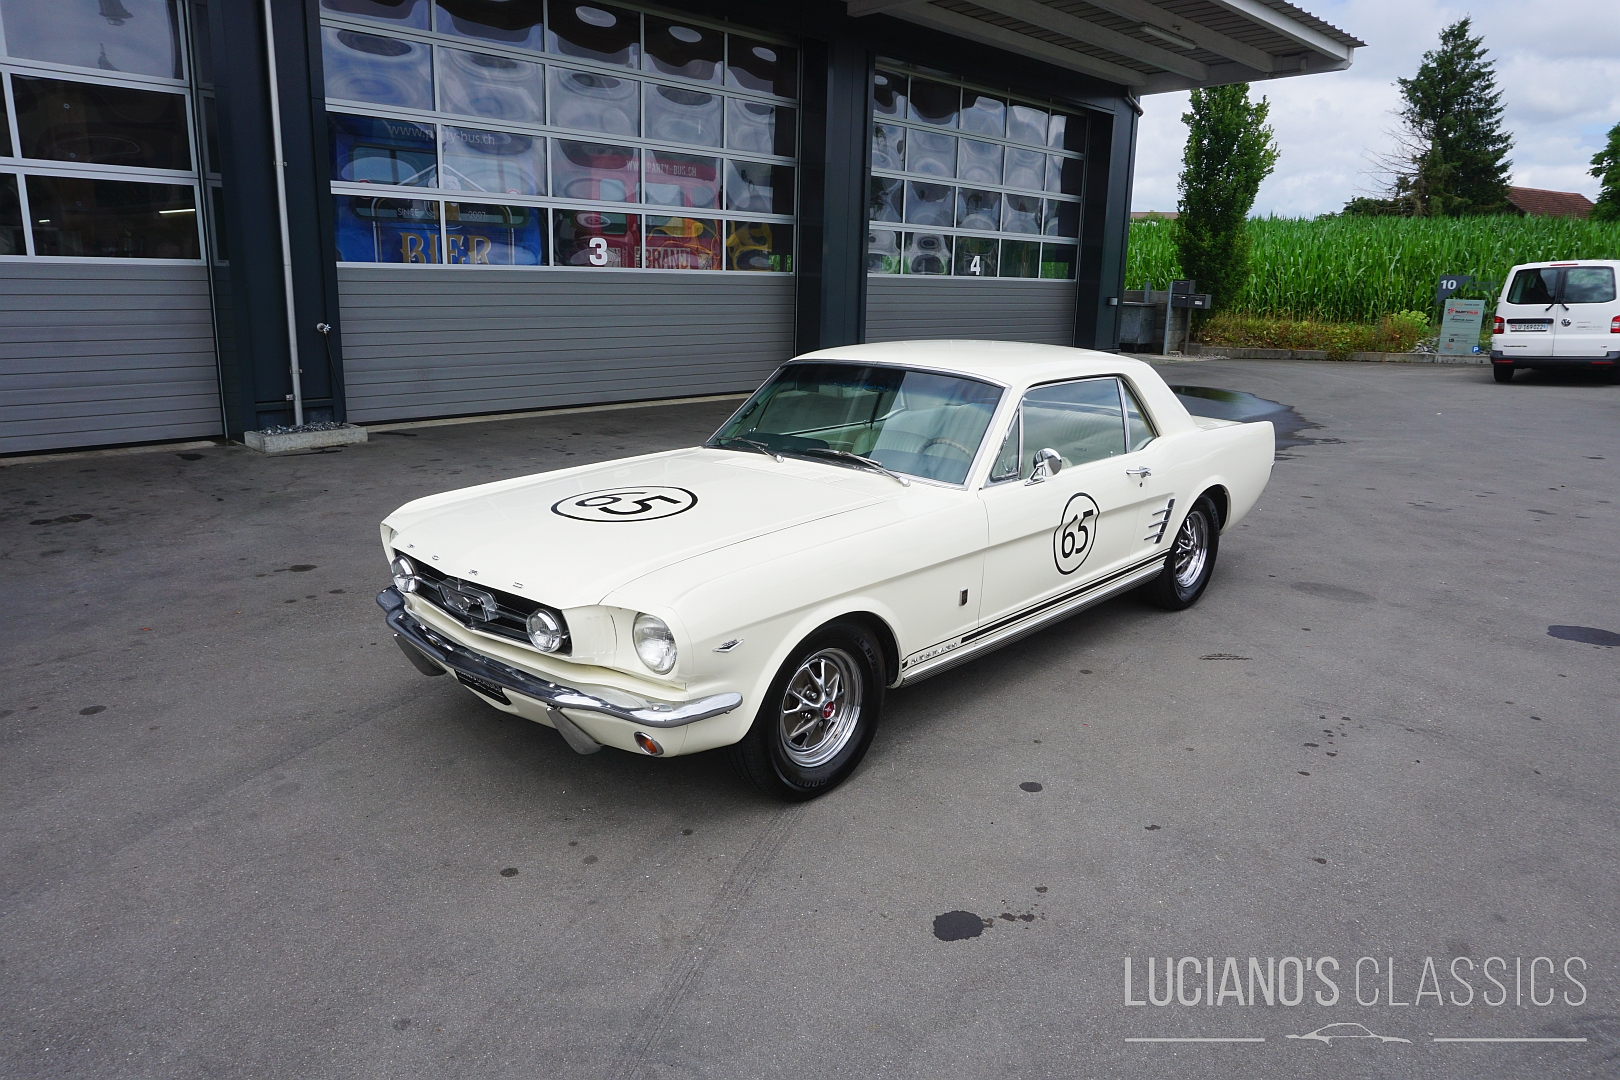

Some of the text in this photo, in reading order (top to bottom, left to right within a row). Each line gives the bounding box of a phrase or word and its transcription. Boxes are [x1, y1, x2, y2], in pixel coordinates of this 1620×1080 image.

[388, 123, 495, 146] www.prty-bus.ch
[626, 160, 697, 177] WW.PARTY-BUS.CH
[397, 207, 486, 219] SINCE 2007
[399, 231, 492, 265] BIER
[589, 237, 608, 266] 3
[970, 255, 981, 276] 4
[1440, 279, 1457, 290] 10
[574, 491, 683, 515] 65
[1061, 508, 1094, 559] 65
